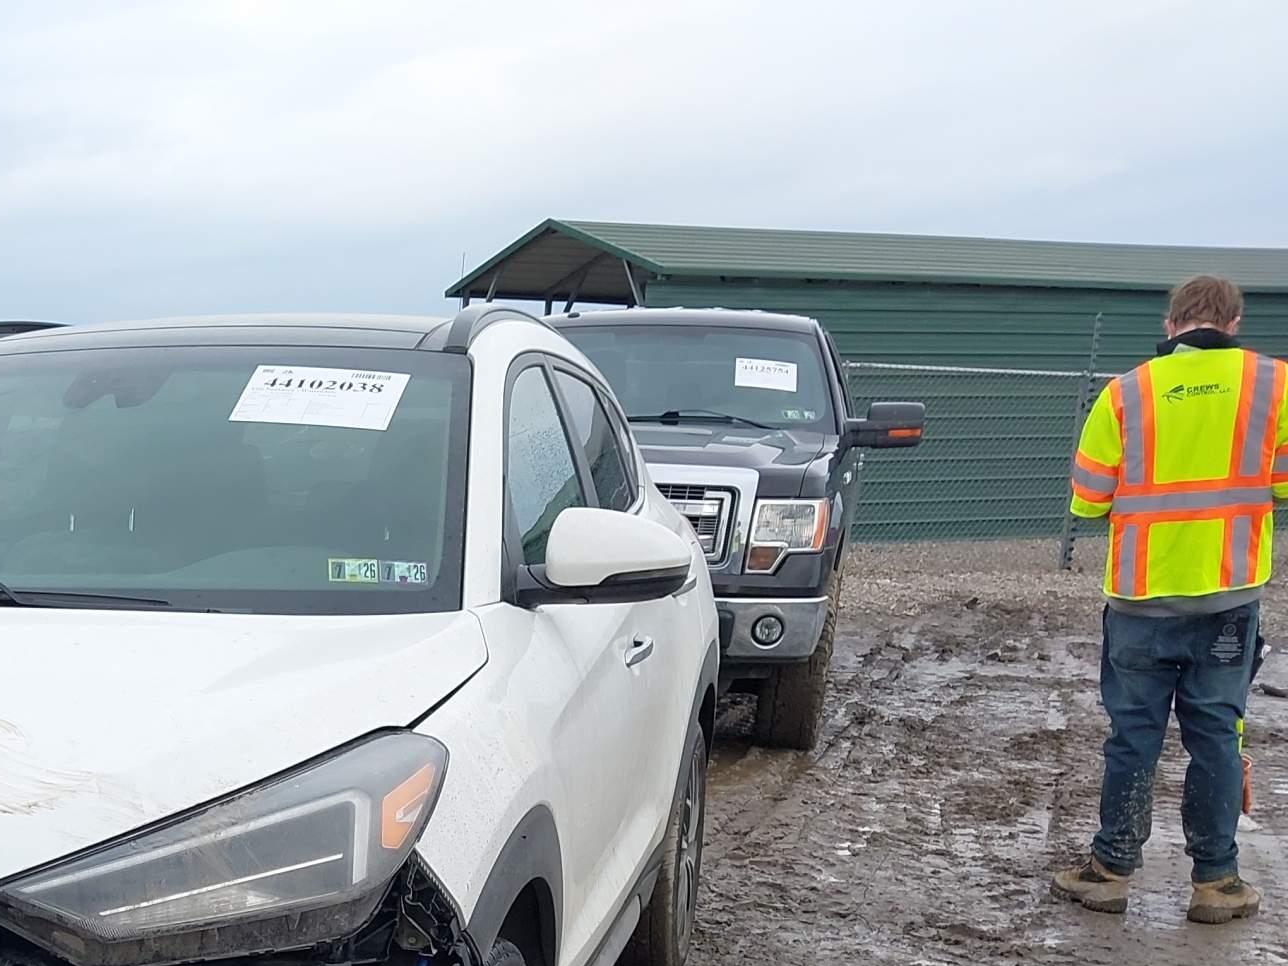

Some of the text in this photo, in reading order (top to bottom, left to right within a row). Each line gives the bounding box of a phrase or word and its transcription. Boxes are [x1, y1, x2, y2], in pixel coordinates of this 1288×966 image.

[264, 377, 385, 394] 44102038
[1187, 384, 1220, 393] CREWS
[363, 562, 376, 579] 26
[414, 565, 426, 581] 26
